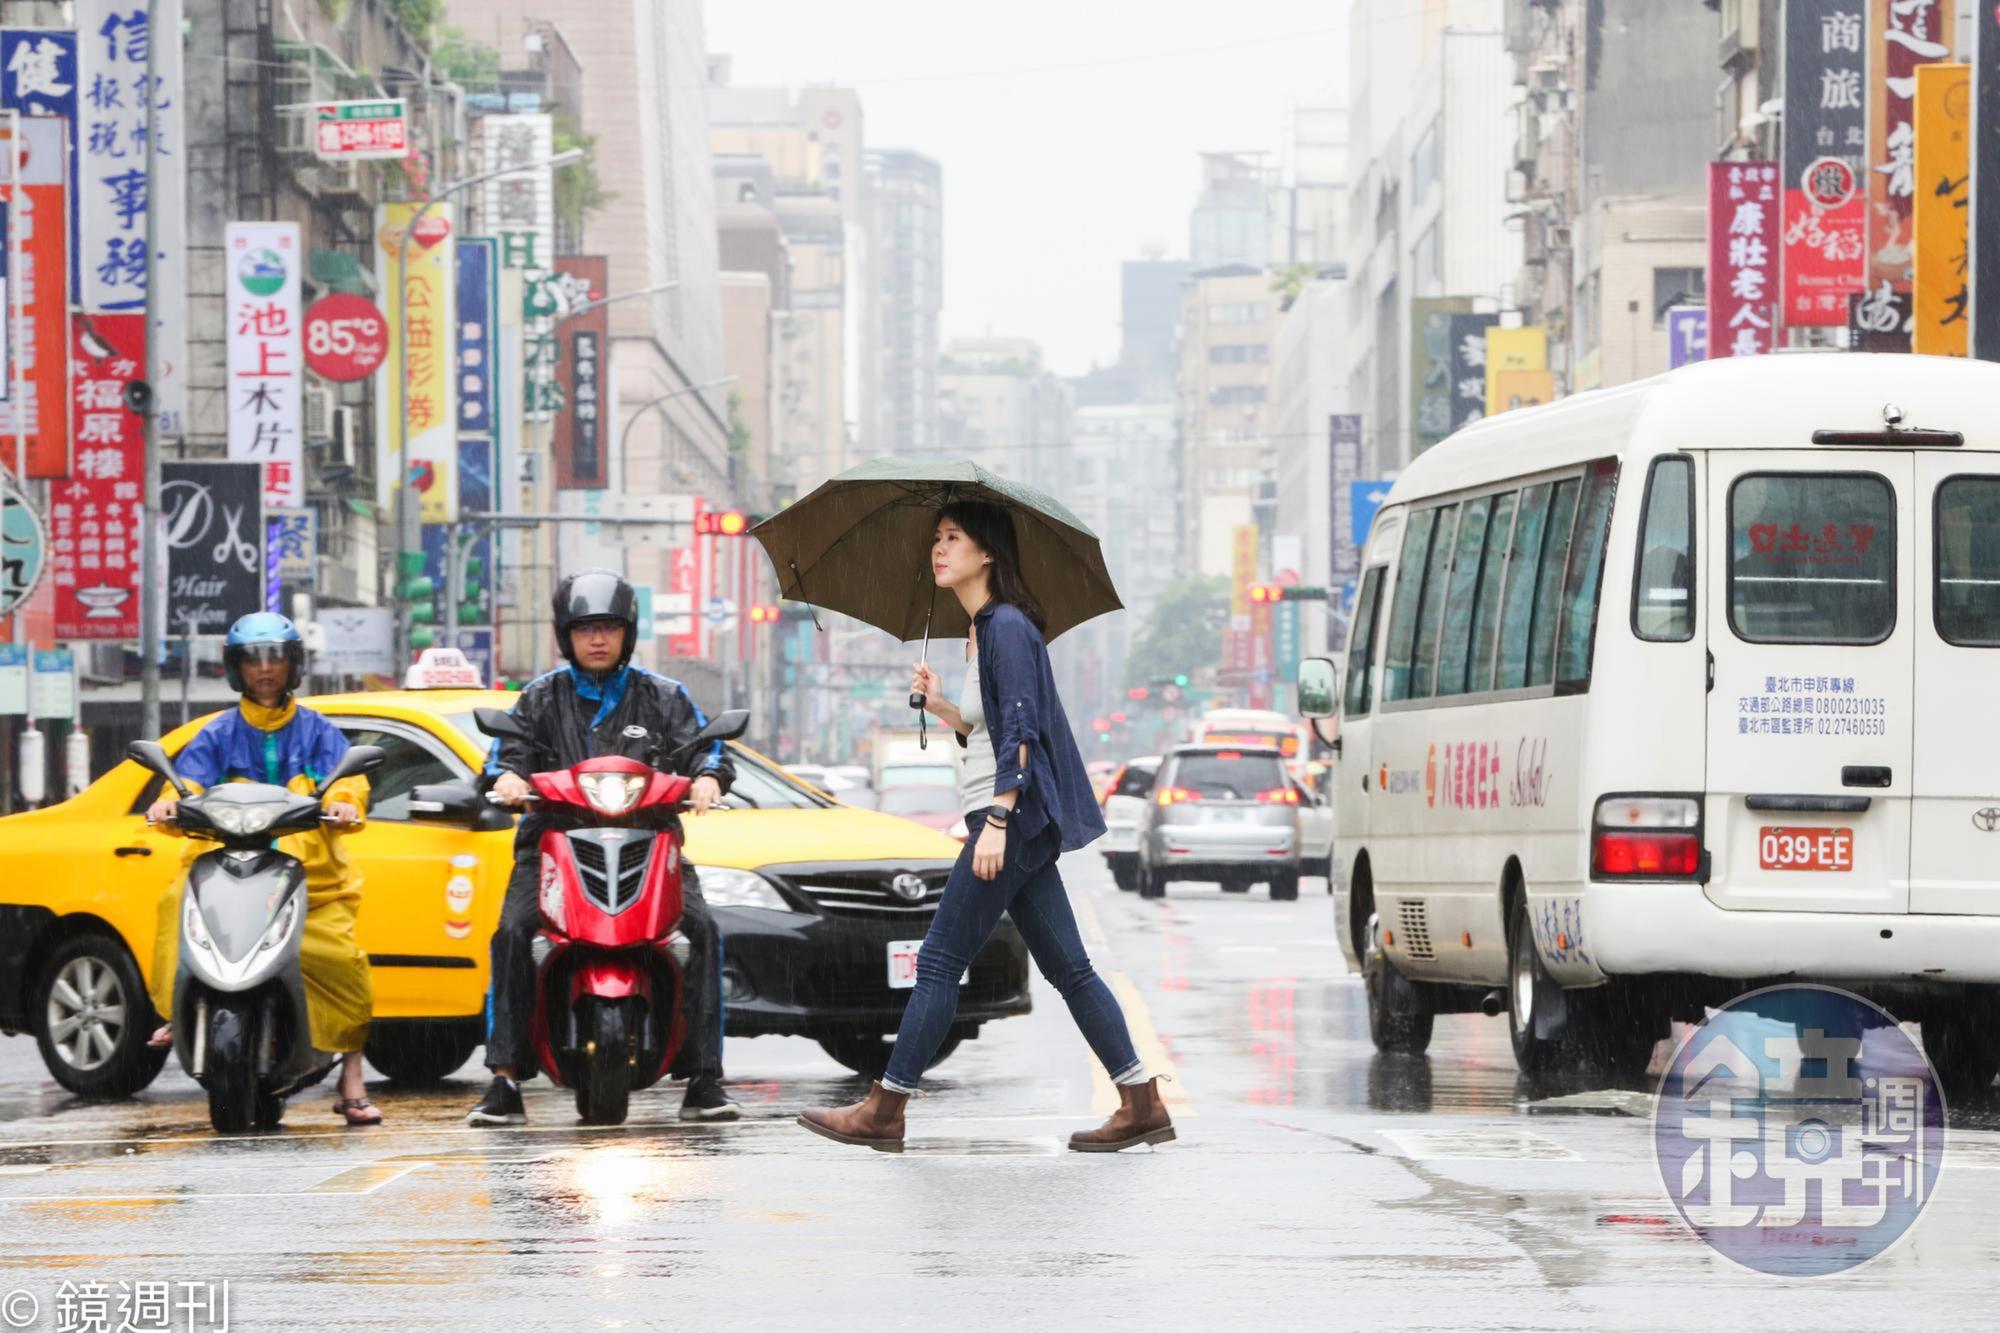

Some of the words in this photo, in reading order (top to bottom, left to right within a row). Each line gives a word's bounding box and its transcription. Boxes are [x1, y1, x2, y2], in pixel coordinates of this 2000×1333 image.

[1821, 11, 1861, 109] 商旅
[7, 38, 73, 115] 健
[97, 168, 148, 310] 事務
[172, 574, 227, 597] Hair
[172, 603, 228, 625] Salon
[1765, 676, 1855, 694] 臺北市申訴專線
[1739, 697, 1814, 714] 交通部公路總局
[1816, 698, 1885, 715] 0800231035
[1738, 717, 1814, 735] 臺北市區監理所
[1762, 835, 1850, 865] 039-EE
